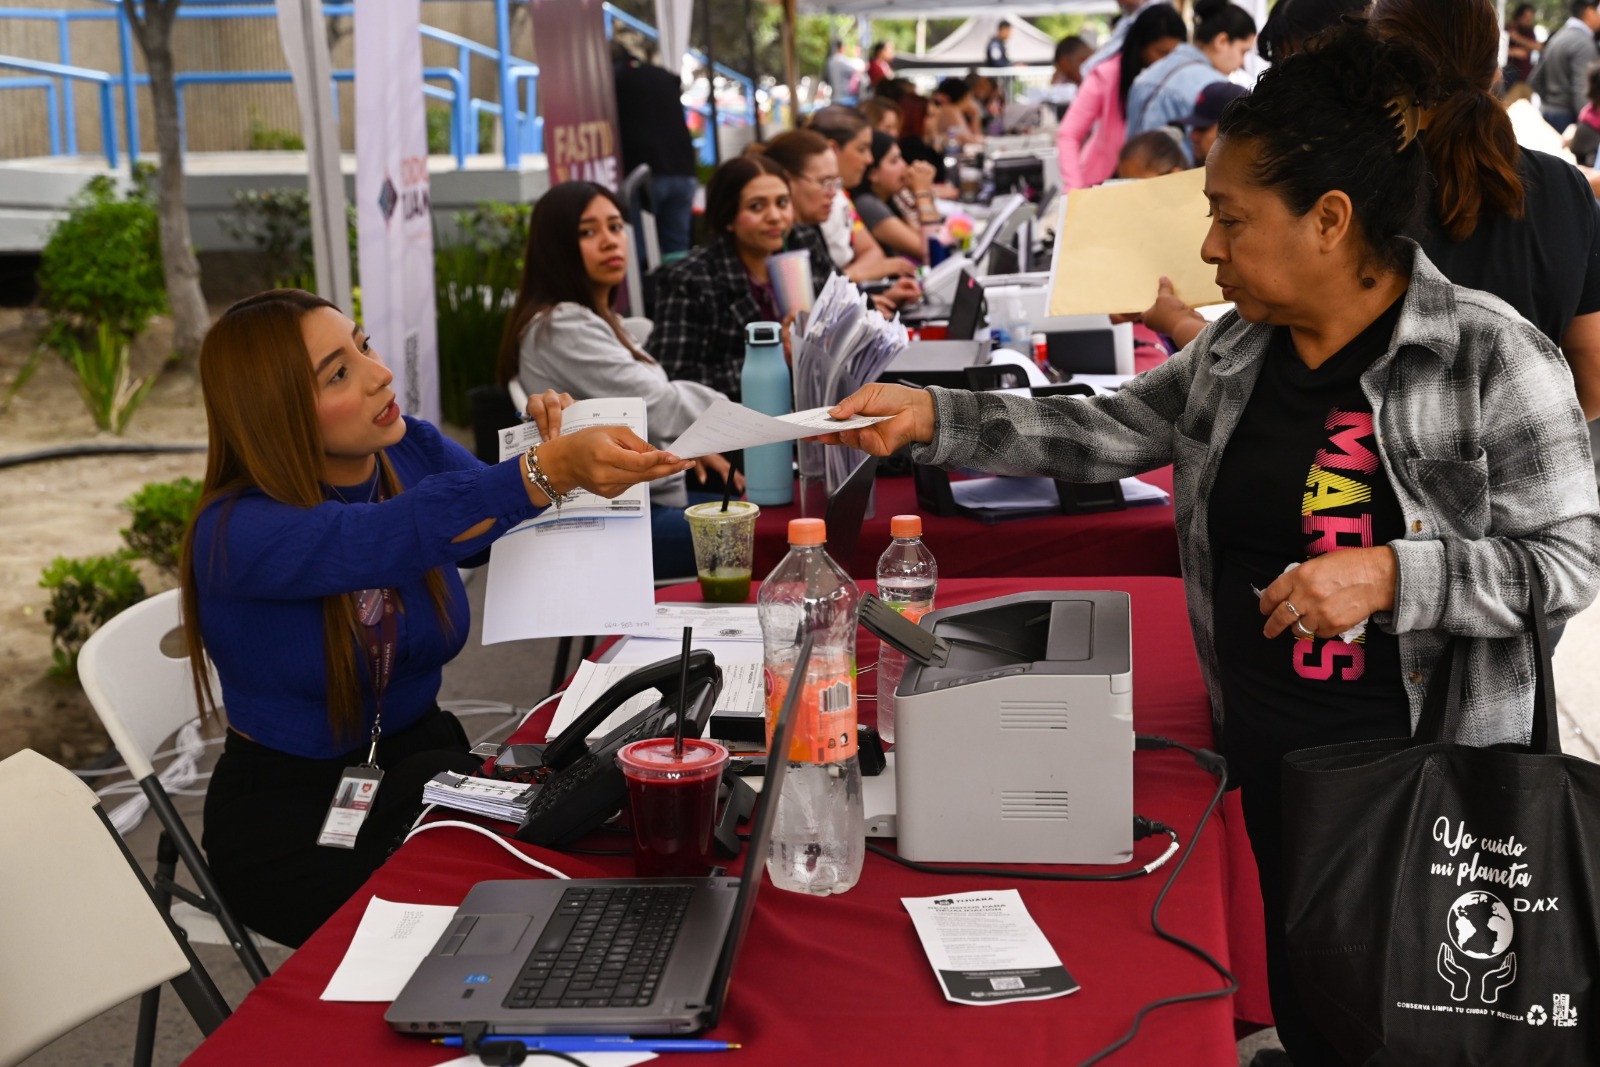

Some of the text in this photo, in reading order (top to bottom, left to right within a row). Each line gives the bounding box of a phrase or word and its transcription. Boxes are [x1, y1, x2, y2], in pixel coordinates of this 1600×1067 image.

[1432, 816, 1527, 857] Yo cuido
[1430, 852, 1532, 889] mi planeta
[1396, 1001, 1431, 1011] CONSERVA
[1431, 1004, 1453, 1013] LIMPIA
[1455, 1006, 1465, 1014] TU
[1465, 1007, 1488, 1016] CIUDAD
[1496, 1011, 1524, 1021] RECICLA
